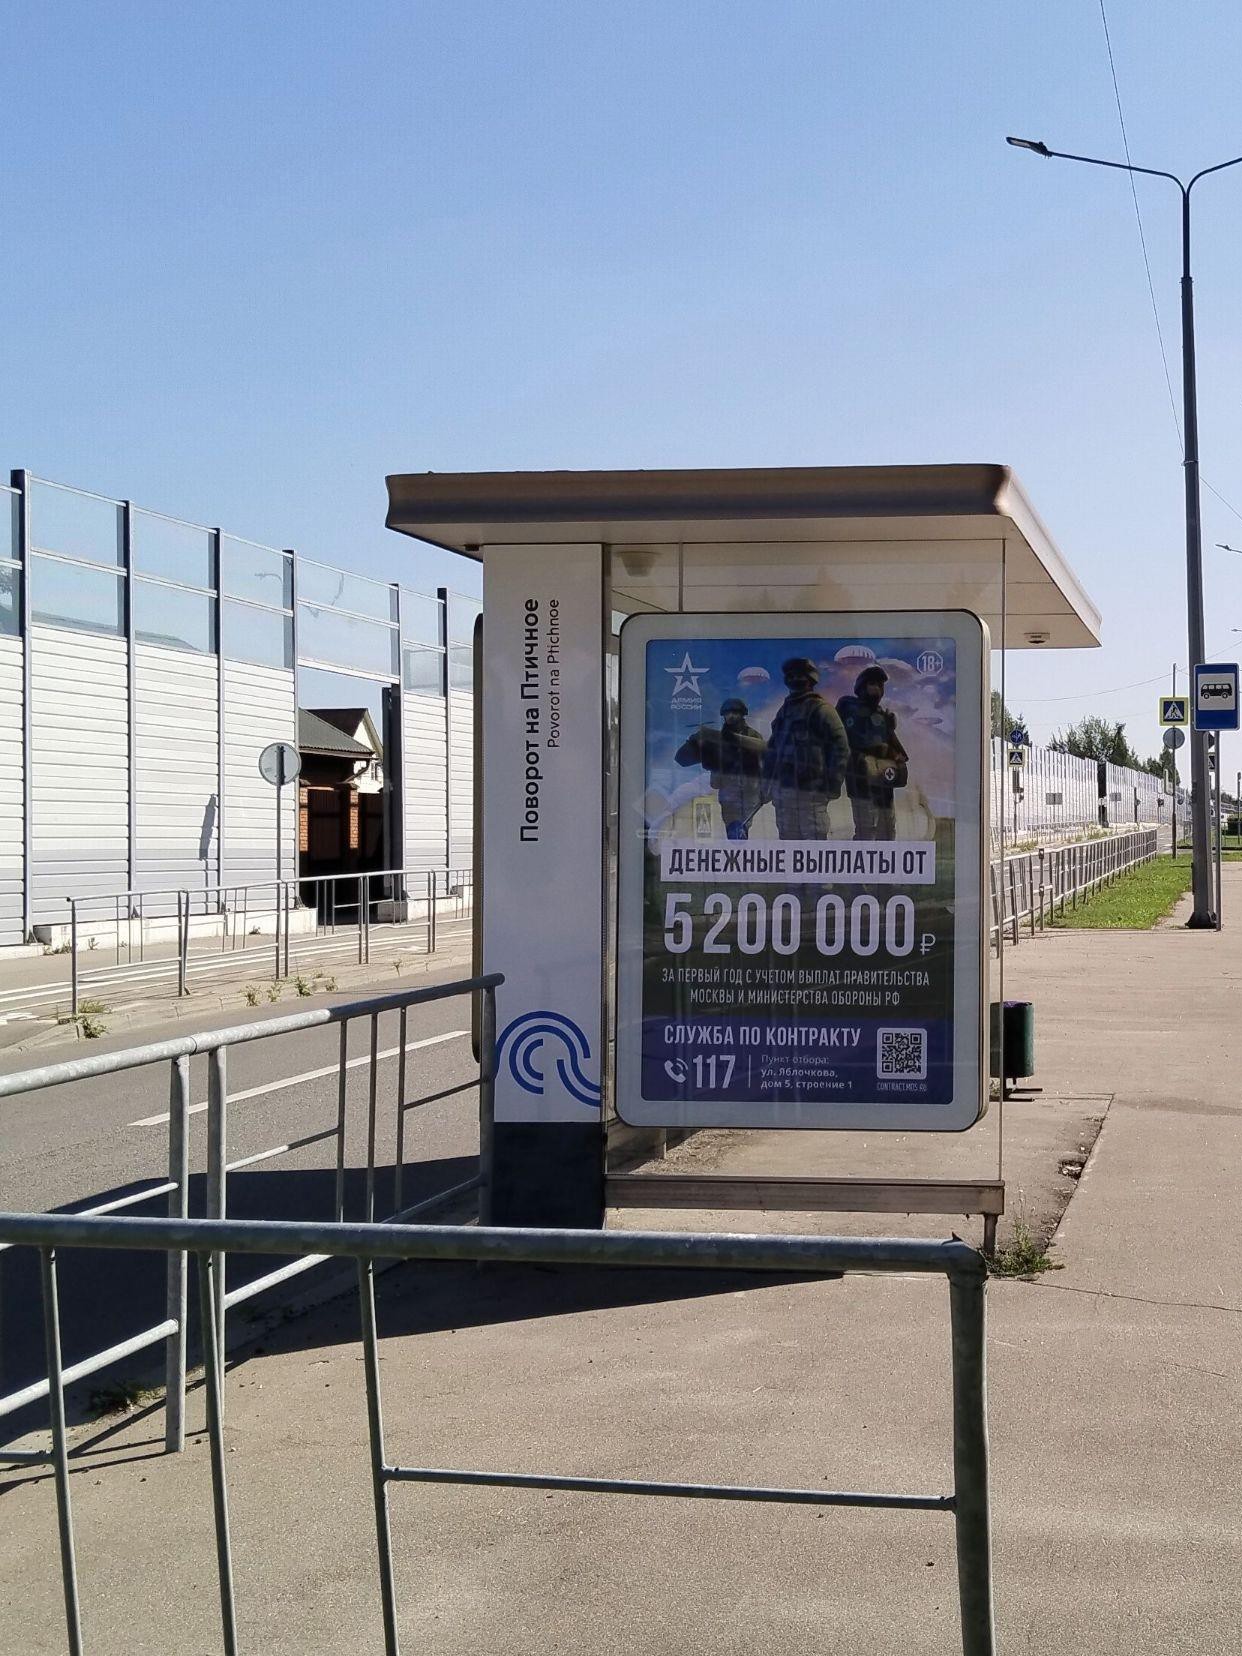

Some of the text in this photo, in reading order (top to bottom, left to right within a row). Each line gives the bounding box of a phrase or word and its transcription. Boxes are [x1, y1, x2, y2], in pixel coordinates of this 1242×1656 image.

[922, 655, 942, 671] 18+
[546, 599, 560, 748] Povorot na Ptichnoe
[520, 598, 543, 842] Поворот на Птичное
[669, 848, 927, 875] ДЕНЕЖНЫЕ ВЫПЛАТЫ ОТ
[662, 966, 930, 986] ЗА ПЕРВЫЙ ГОД С УЧЕТОМ ВЫПЛАТ ПРАВИТЕЛЬСТВА
[690, 988, 900, 1006] МОСКВЫ И МИНИСТЕРСТВА ОБОРОНЫ РФ
[664, 1025, 861, 1047] СЛУЖБА ПО КОНТРАКТУ
[761, 1054, 790, 1065] Пункт
[692, 1054, 736, 1089] 117
[761, 1067, 838, 1078] ул. Яблочкова,
[760, 1081, 782, 1090] дом
[784, 1079, 794, 1089] 5,
[795, 1081, 845, 1090] строение
